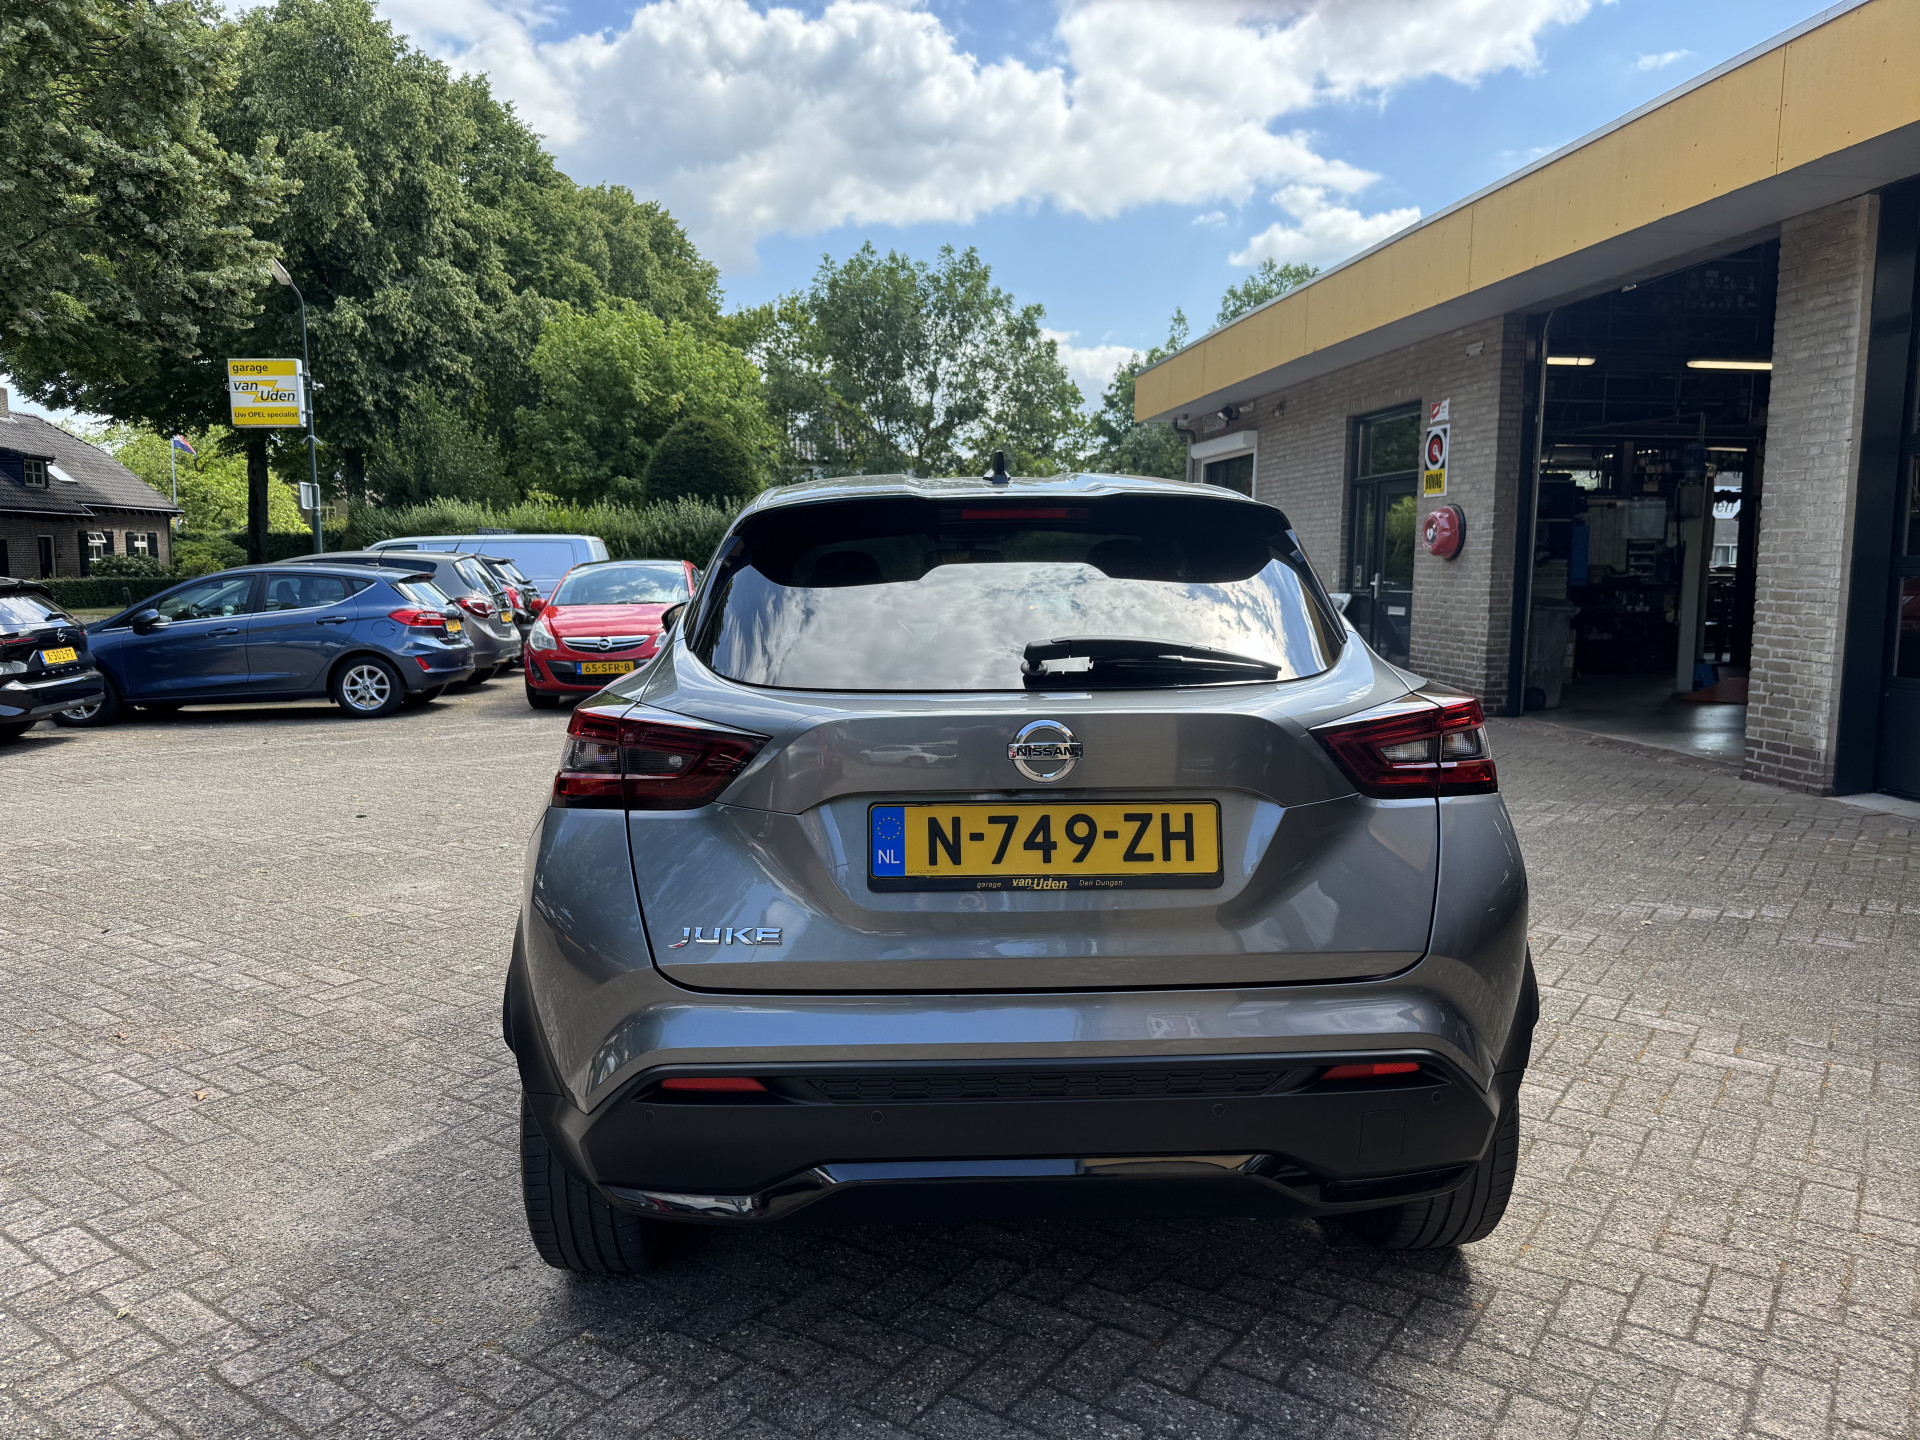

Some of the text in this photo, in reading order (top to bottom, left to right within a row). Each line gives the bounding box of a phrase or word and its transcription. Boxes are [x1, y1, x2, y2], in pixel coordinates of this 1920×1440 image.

[232, 364, 268, 374] garage
[233, 382, 258, 391] van
[260, 390, 295, 401] Uden
[267, 411, 298, 419] specialist
[1425, 473, 1442, 490] BOVAG
[585, 663, 631, 673] 65-SFR-8
[1016, 746, 1075, 757] NISSAN
[927, 812, 1195, 866] N-749-ZH
[878, 849, 900, 864] NL
[976, 878, 1123, 890] garage van Uden Den Dungen
[668, 926, 782, 949] JUKE
